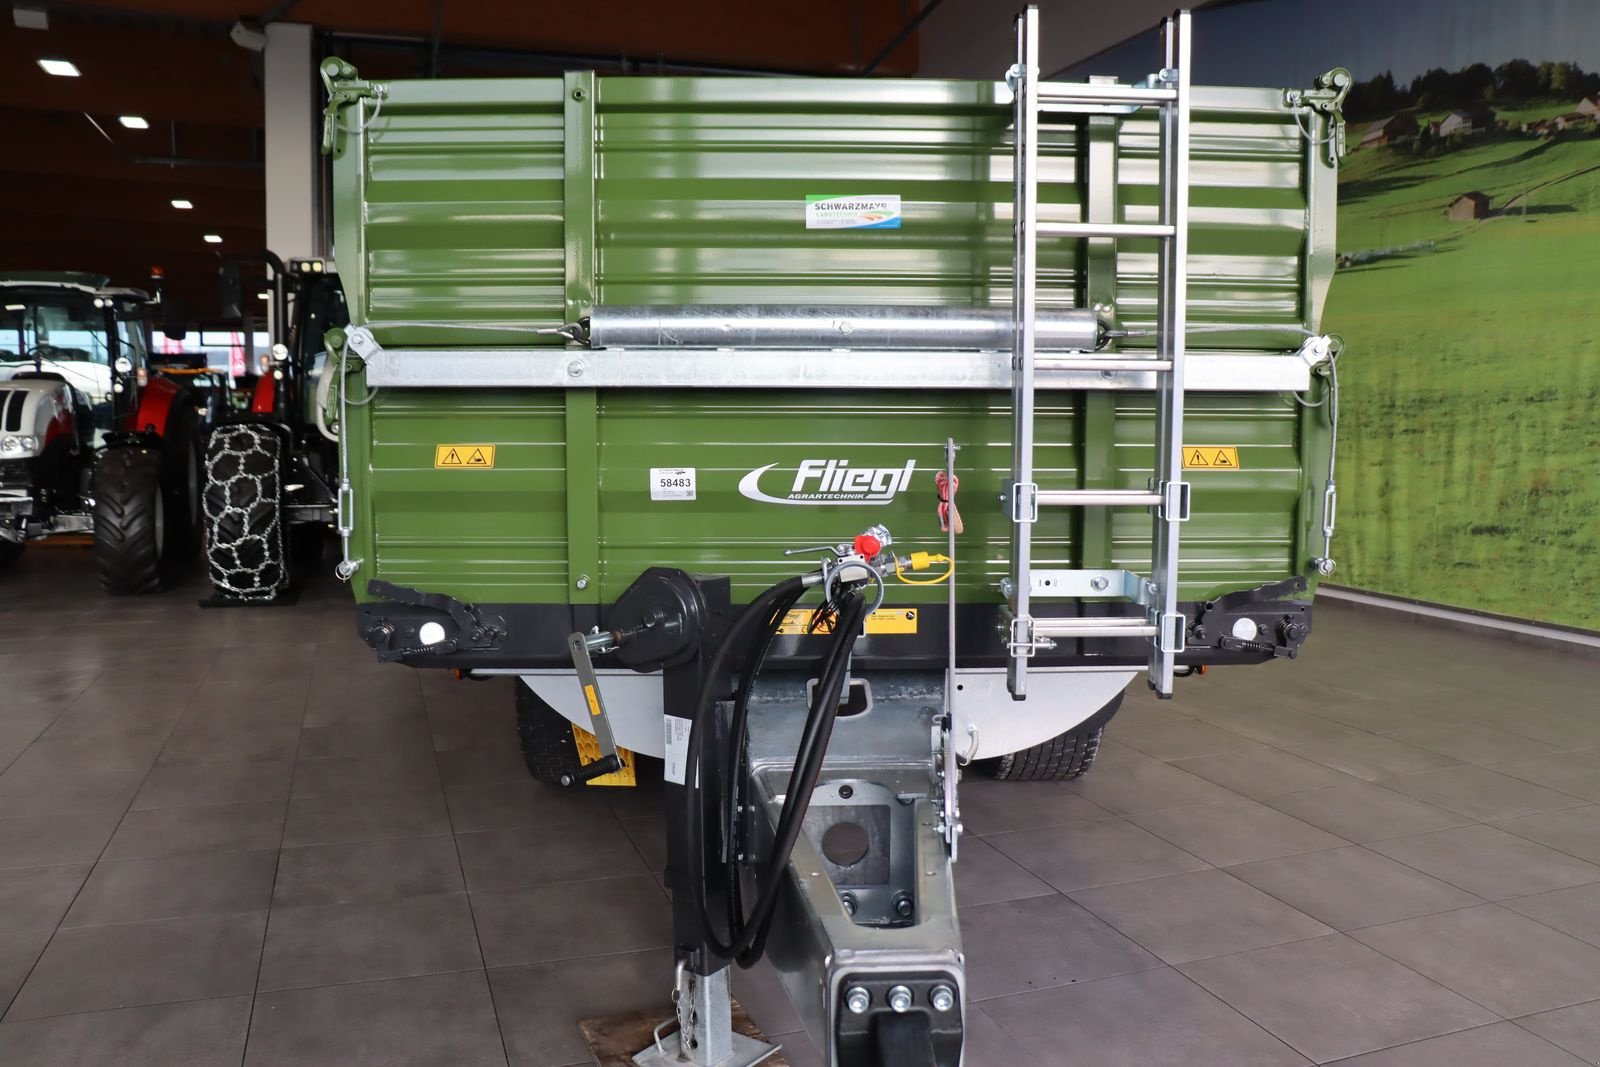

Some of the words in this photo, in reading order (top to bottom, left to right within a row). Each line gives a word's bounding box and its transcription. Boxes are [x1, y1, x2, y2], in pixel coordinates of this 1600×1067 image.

[815, 202, 888, 210] SCHWARZMAYR
[660, 478, 691, 487] 58483
[791, 459, 917, 499] Fliegl
